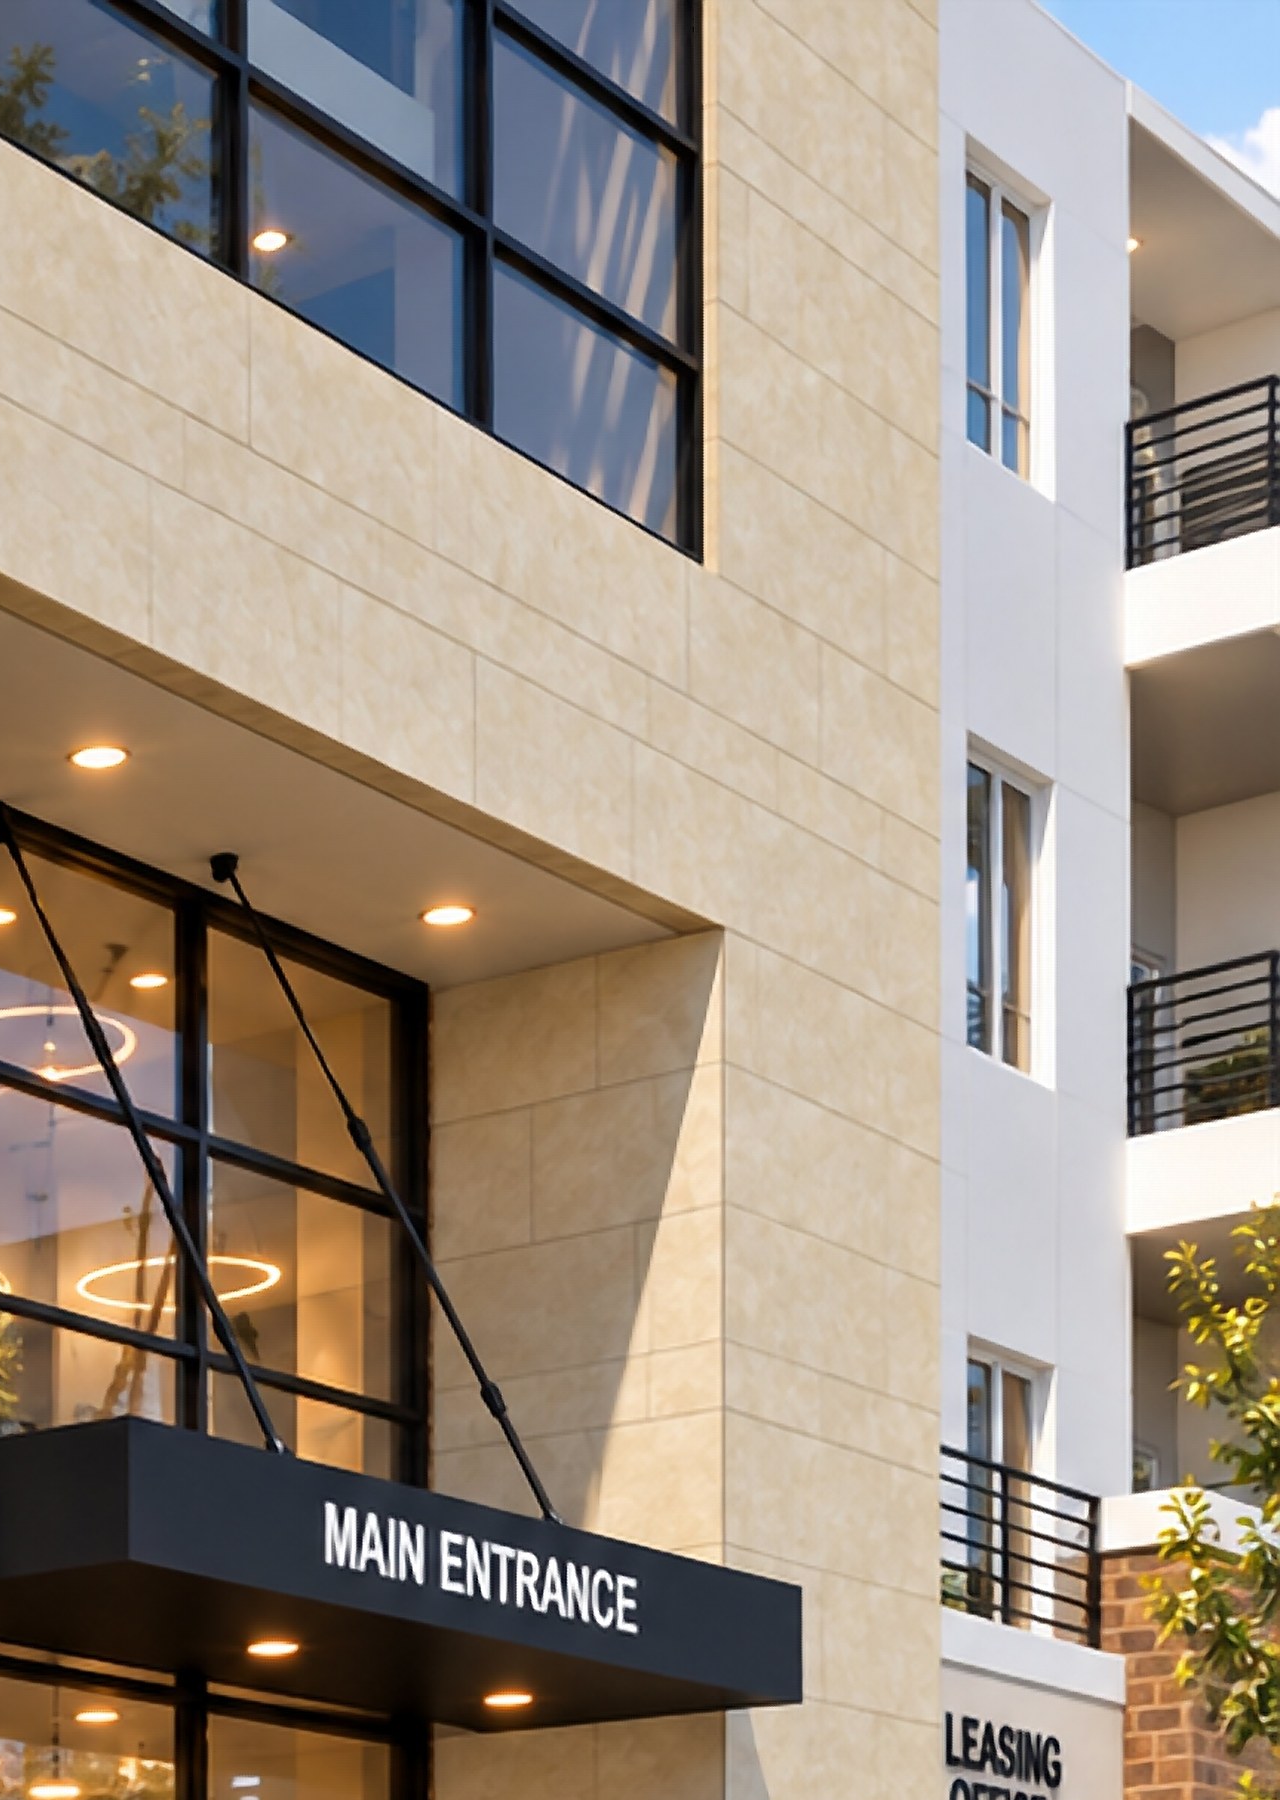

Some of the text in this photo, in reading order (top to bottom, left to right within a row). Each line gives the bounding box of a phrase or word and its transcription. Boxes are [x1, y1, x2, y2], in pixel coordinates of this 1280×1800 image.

[324, 1501, 639, 1634] MAIN ENTRANCE
[945, 1711, 1062, 1788] LEASING
